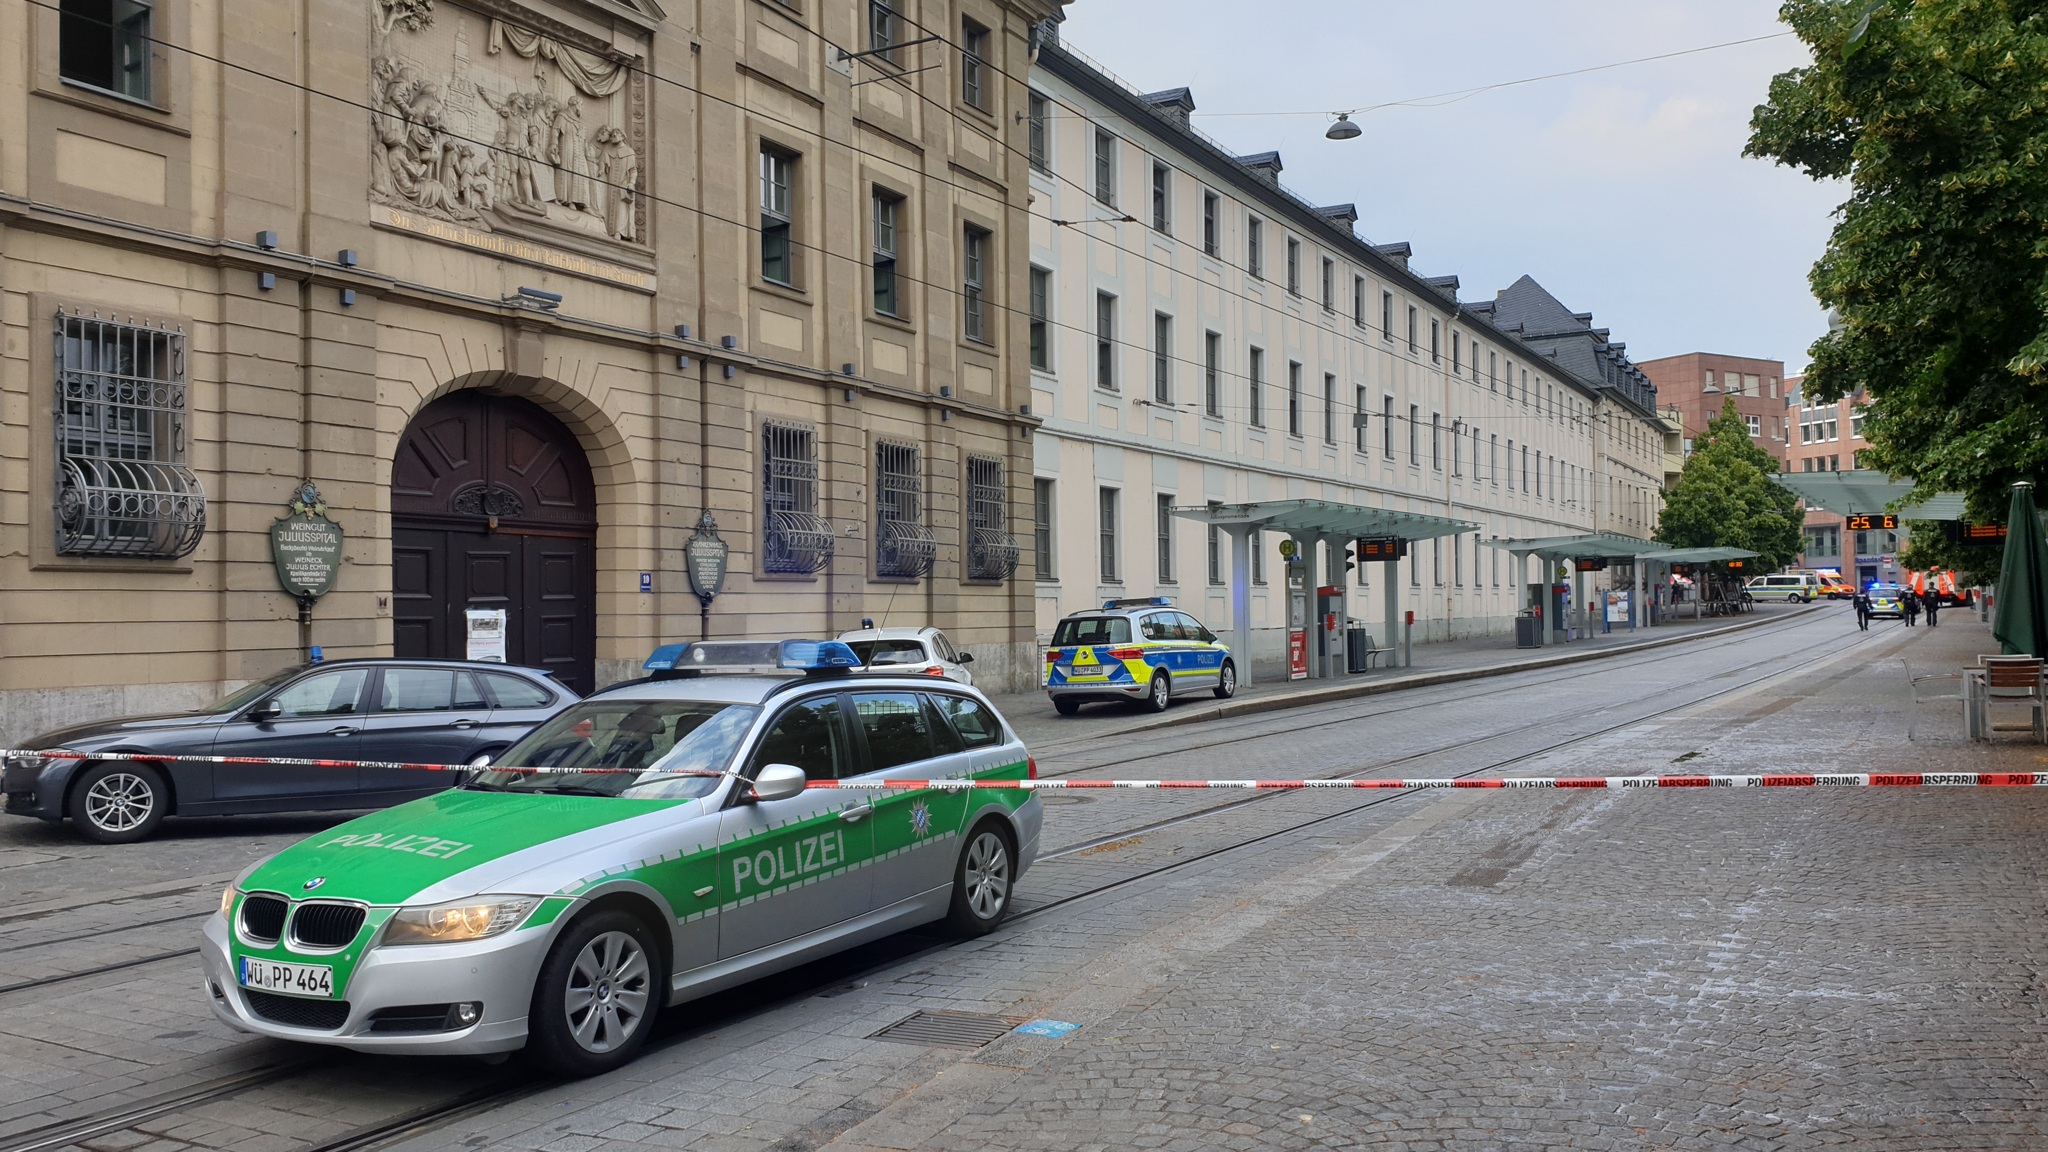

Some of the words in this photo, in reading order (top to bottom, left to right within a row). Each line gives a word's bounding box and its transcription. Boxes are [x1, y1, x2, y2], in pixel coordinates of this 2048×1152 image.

[290, 522, 326, 531] WEINGUT
[278, 531, 338, 544] JULIUSSPITAL
[1197, 654, 1215, 665] POLIZEI
[1747, 776, 1861, 787] POLIZEIABSPERRUNG
[1874, 774, 1993, 786] POLIZEIABSPERRUNG
[317, 833, 474, 859] POLIZEI
[733, 829, 845, 894] POLIZEI
[246, 960, 263, 985] WÜ
[273, 965, 293, 989] PP
[296, 967, 331, 993] 464
